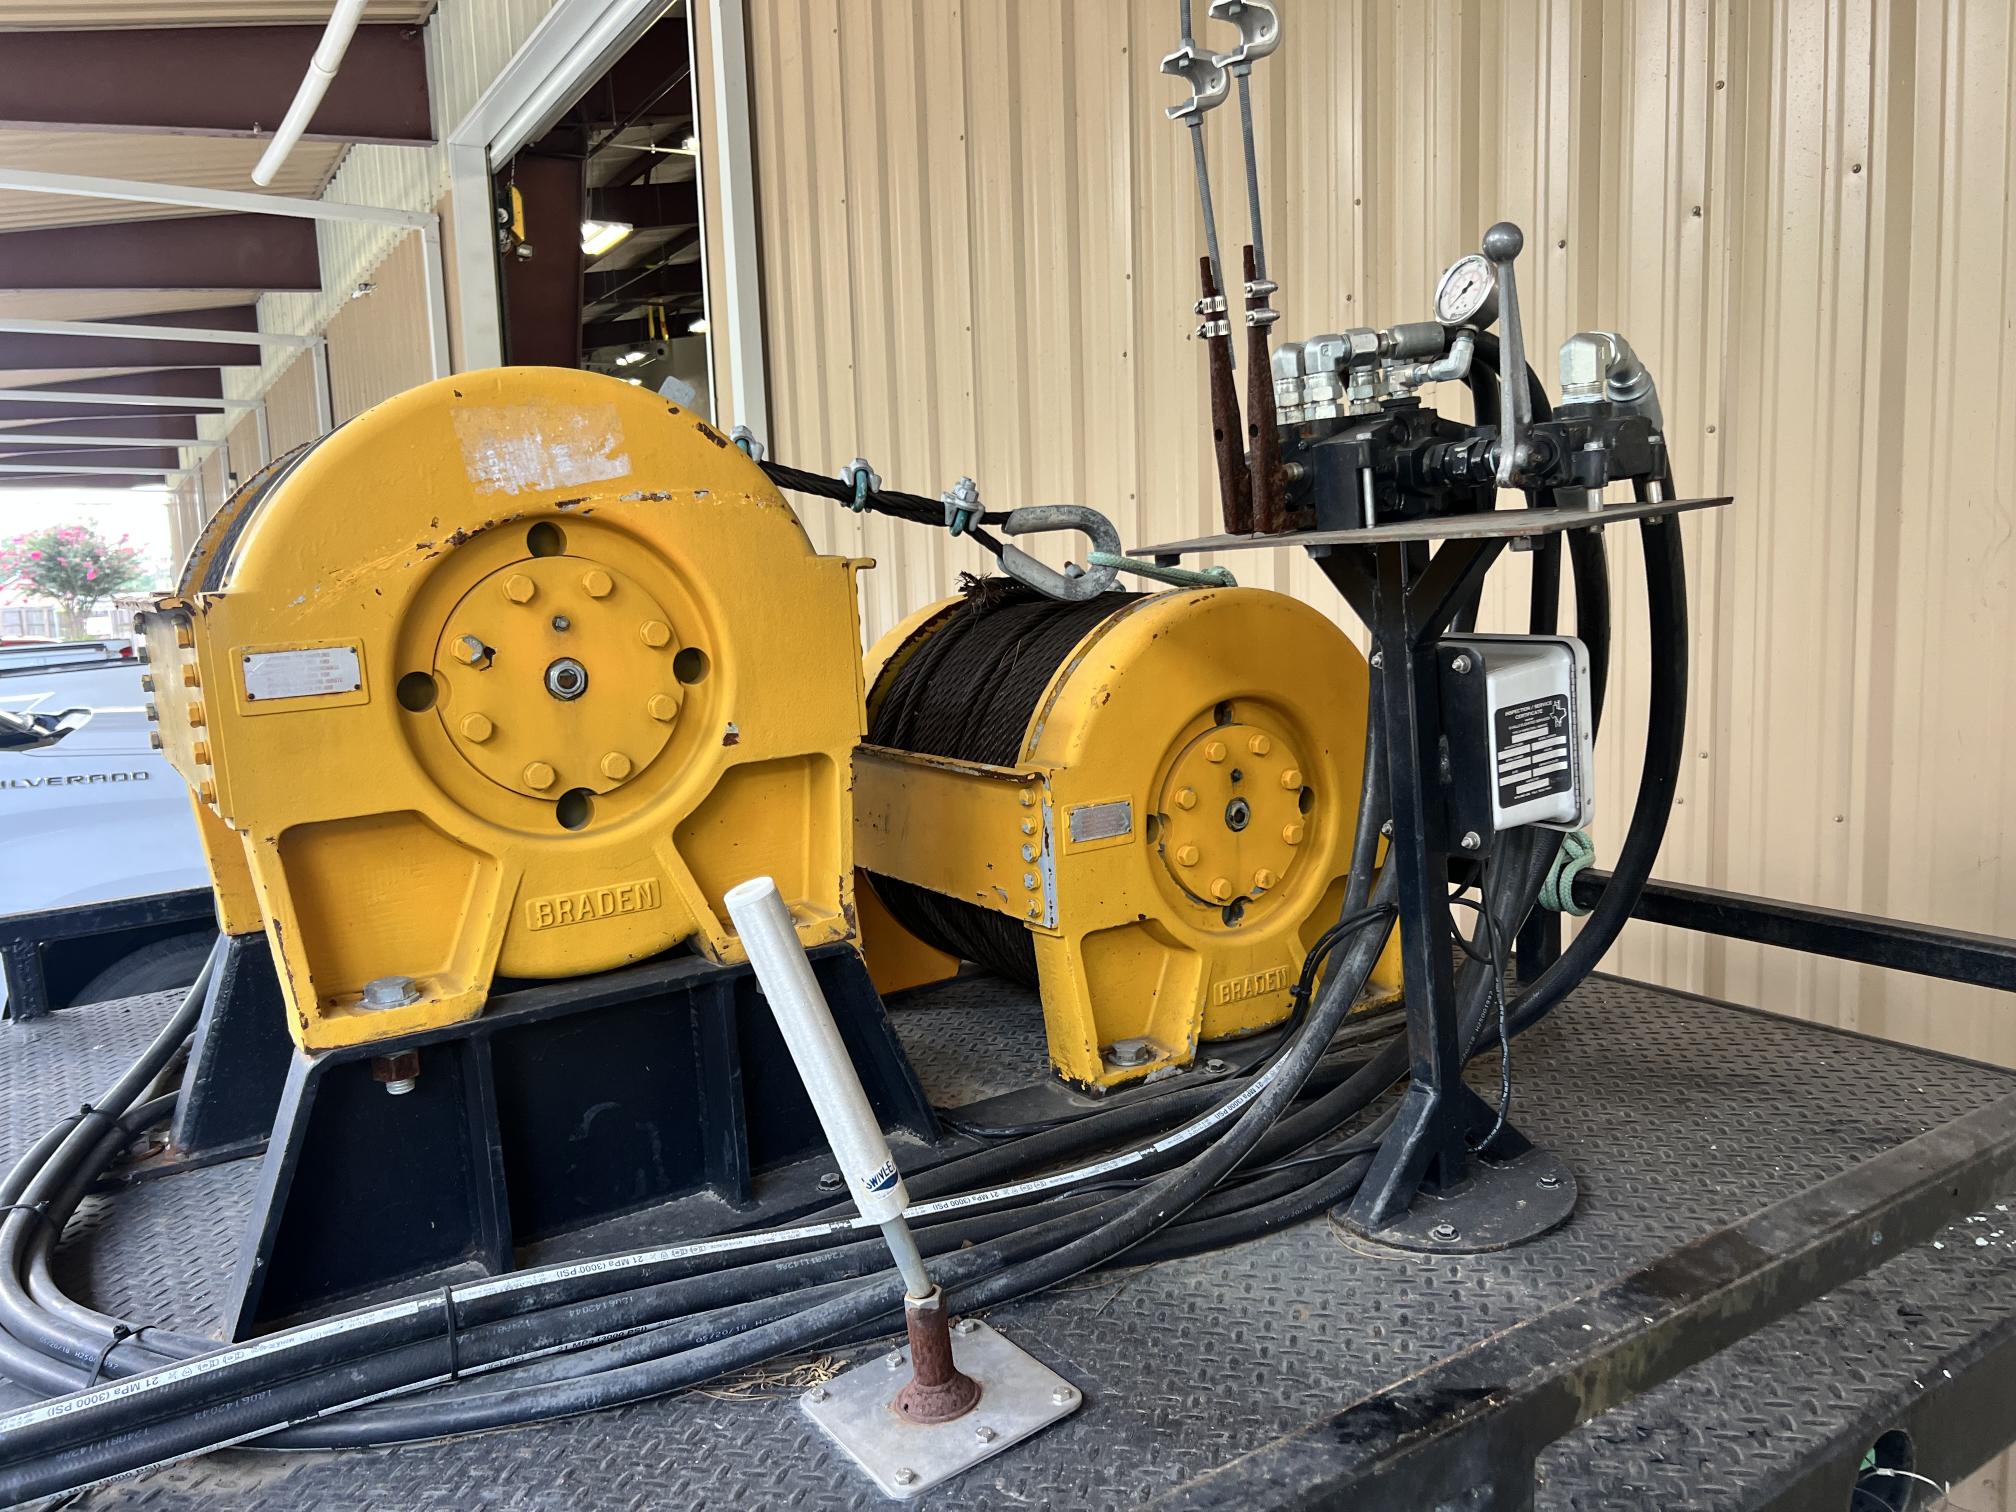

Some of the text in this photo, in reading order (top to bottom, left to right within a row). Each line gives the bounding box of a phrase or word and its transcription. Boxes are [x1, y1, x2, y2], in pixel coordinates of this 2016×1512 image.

[0, 771, 151, 790] ILVERADO
[535, 881, 655, 929] BRADEN
[1218, 966, 1288, 1005] BRADEN
[932, 1202, 948, 1210] PSI)
[950, 1198, 970, 1206] (3000
[972, 1194, 990, 1202] MPa
[556, 1256, 644, 1278] 21 MPa (3000 PSI)
[46, 1376, 160, 1417] 21 MPa (3000 PSI)
